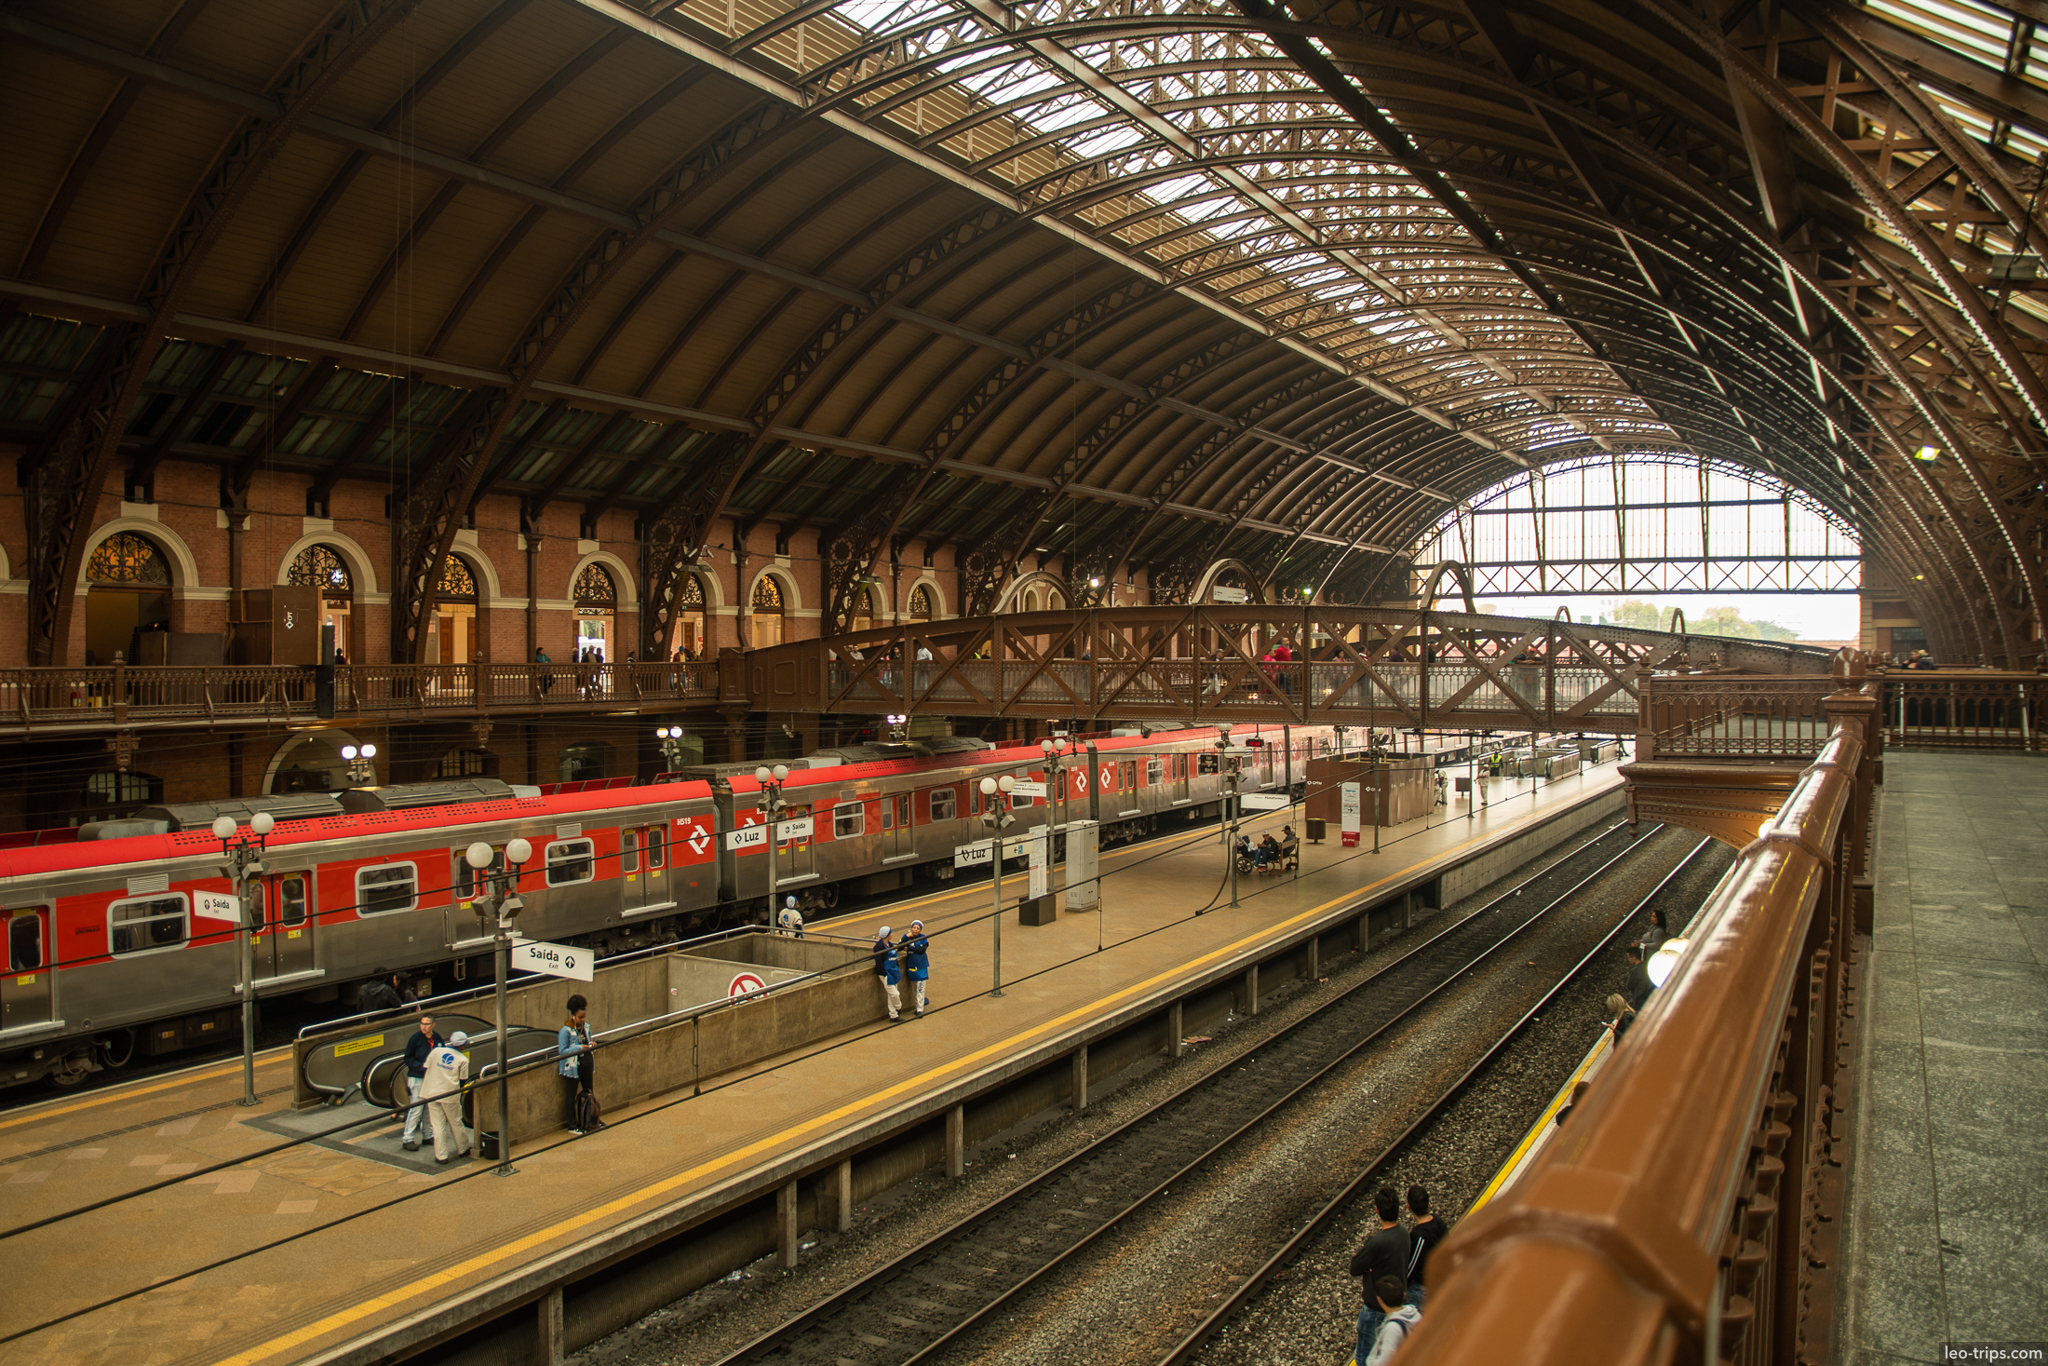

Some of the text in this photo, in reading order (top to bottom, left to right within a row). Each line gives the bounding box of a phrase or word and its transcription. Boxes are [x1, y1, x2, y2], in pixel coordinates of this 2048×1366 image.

[744, 831, 759, 843] Luz
[972, 848, 986, 859] Luz
[530, 947, 559, 962] Saída
